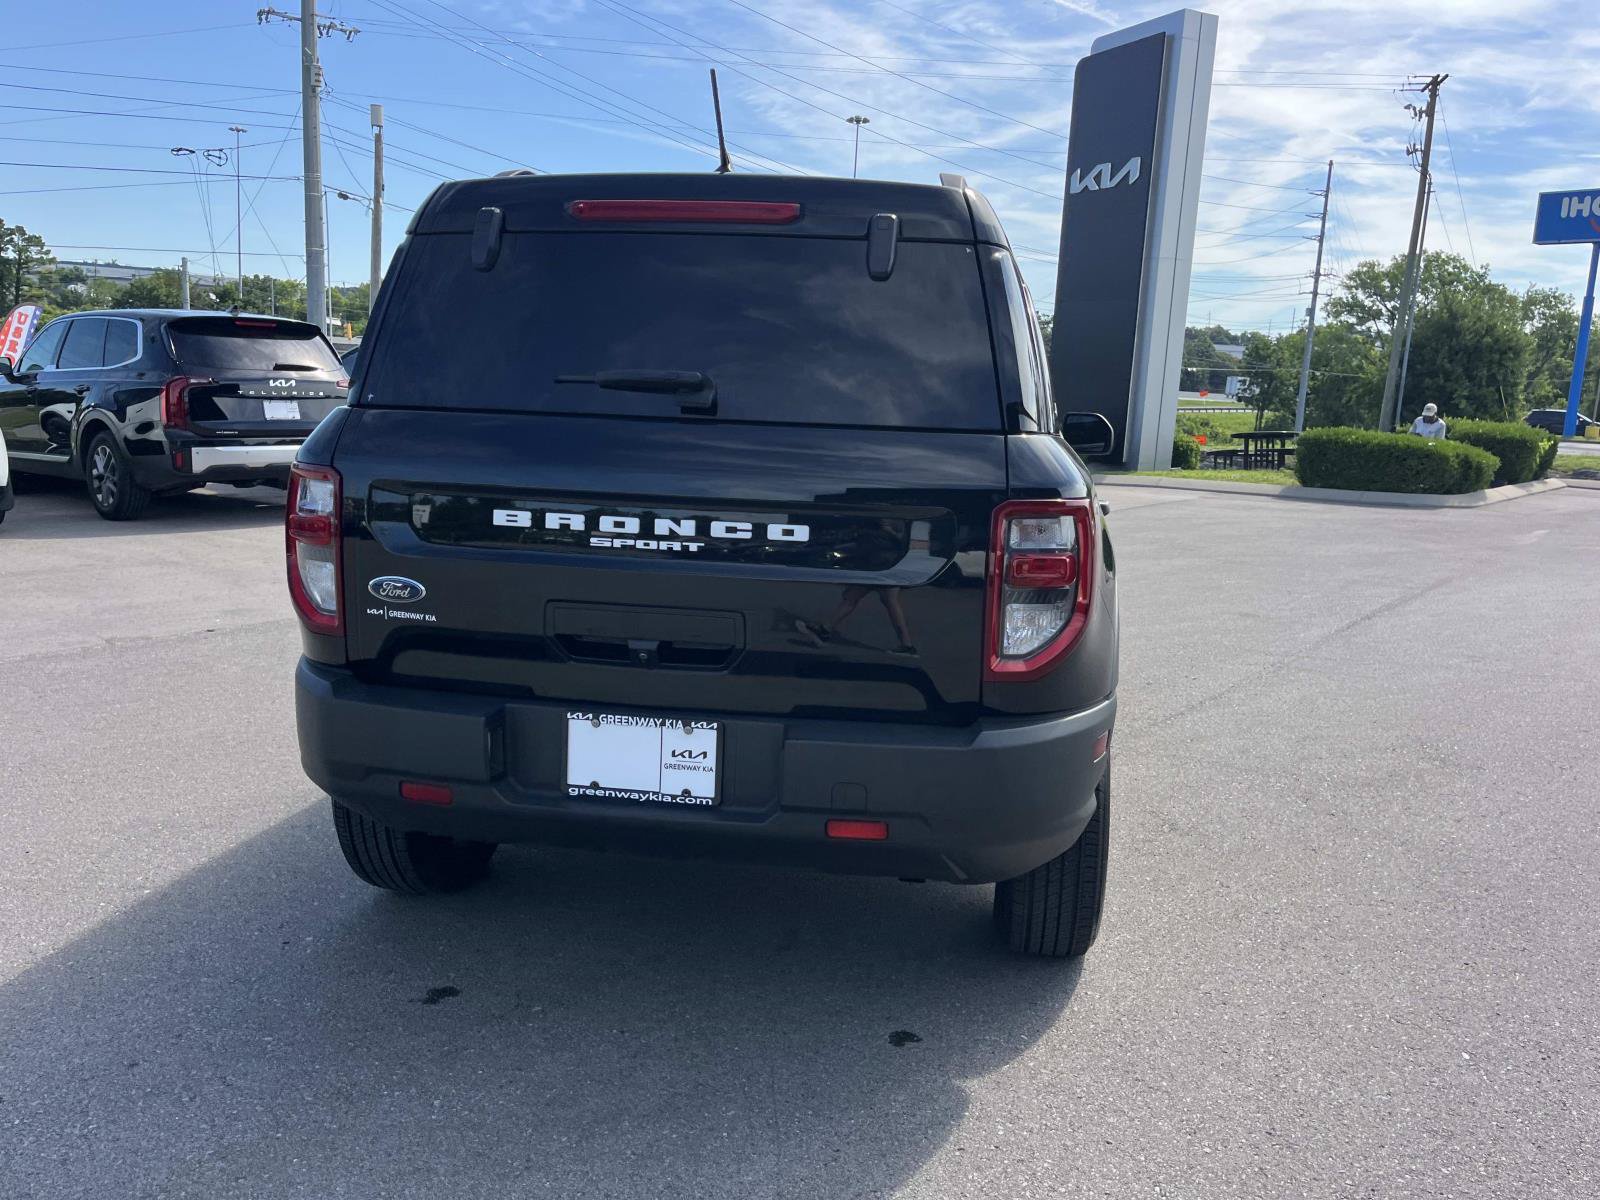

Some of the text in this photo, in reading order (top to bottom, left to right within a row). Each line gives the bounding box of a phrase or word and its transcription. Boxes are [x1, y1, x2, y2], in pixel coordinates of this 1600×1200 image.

[1070, 156, 1141, 194] KIA
[492, 509, 810, 542] BRONCO
[589, 537, 705, 552] SPORT
[380, 581, 411, 598] Ford
[388, 610, 424, 620] GREENWAY
[425, 614, 437, 622] KIA
[598, 714, 663, 729] GREENWAY
[665, 719, 684, 730] KIA
[663, 762, 714, 773] GREENWAY KIA
[568, 786, 713, 806] greenwaykia.com
